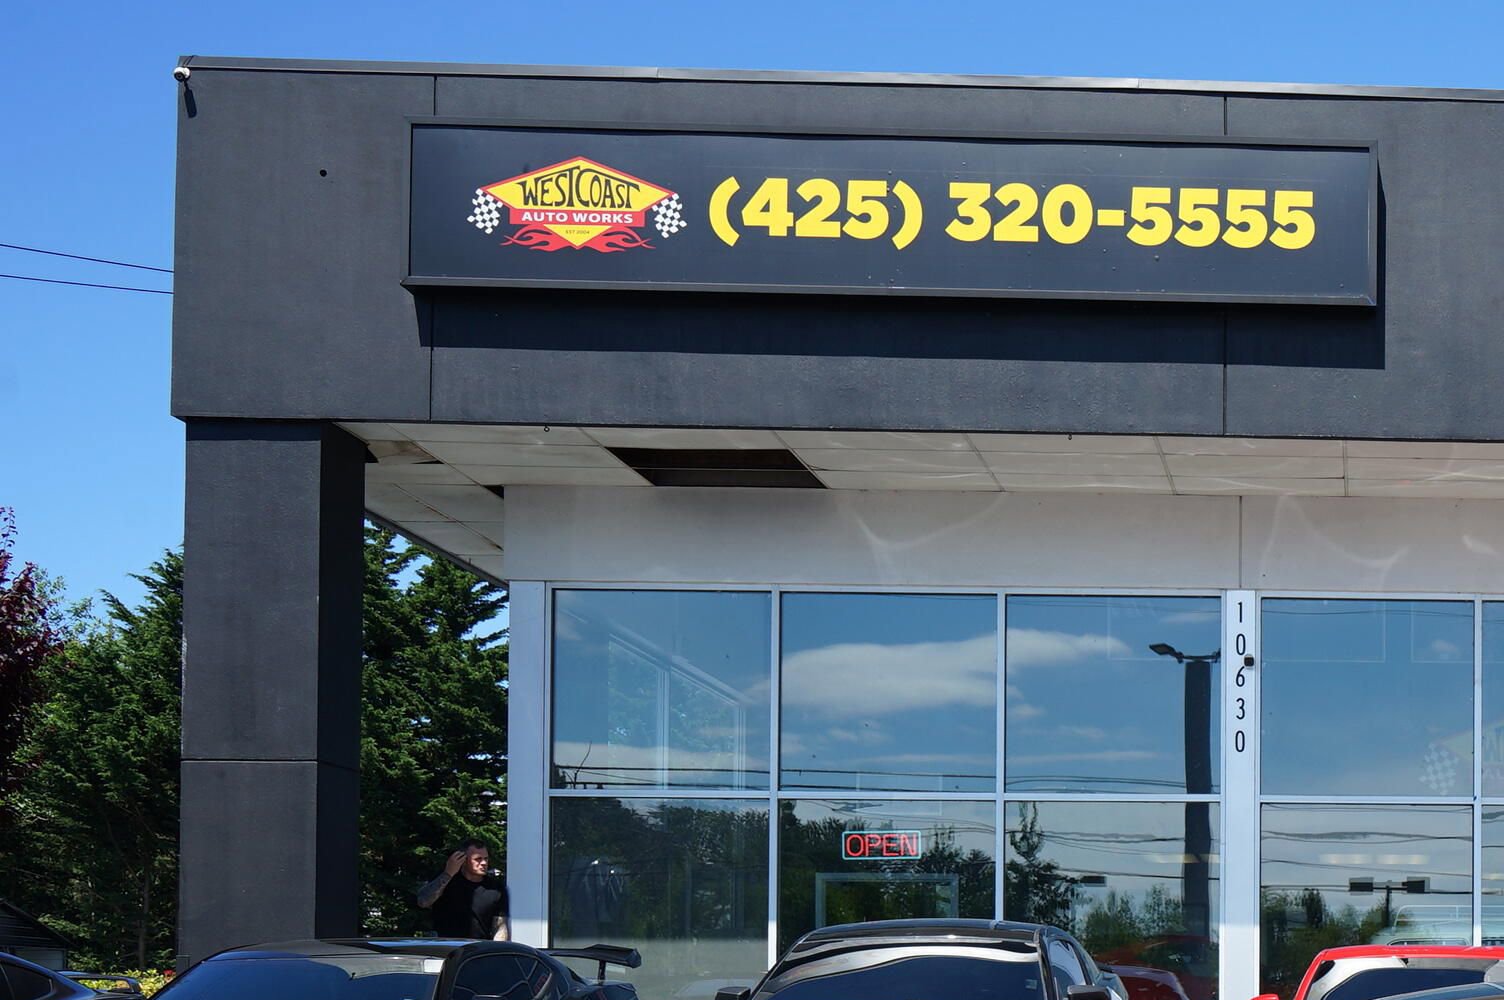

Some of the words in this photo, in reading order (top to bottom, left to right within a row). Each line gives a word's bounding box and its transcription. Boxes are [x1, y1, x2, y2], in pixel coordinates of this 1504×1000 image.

[522, 211, 568, 222] AUTO
[572, 212, 633, 224] WORKS
[709, 176, 922, 250] (425)
[945, 182, 1315, 249] 320-5555
[846, 833, 918, 857] OPEN
